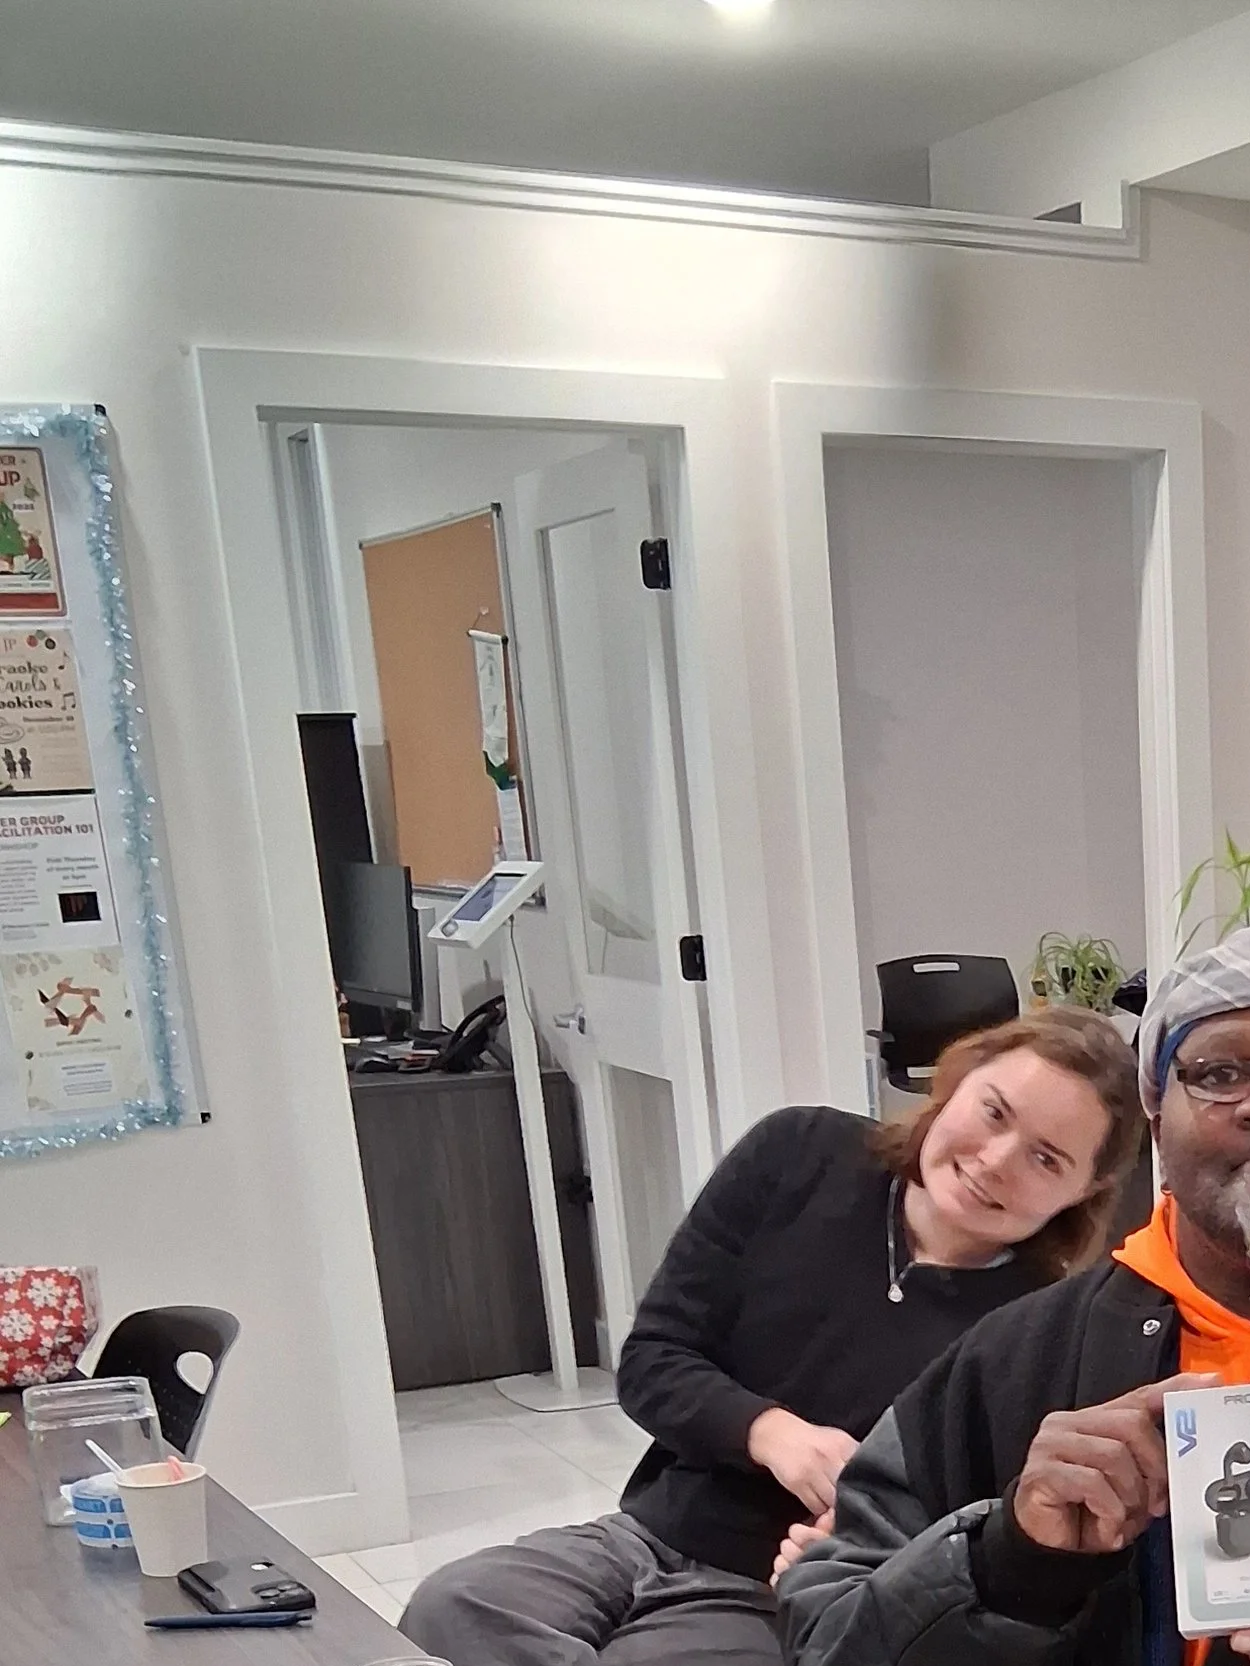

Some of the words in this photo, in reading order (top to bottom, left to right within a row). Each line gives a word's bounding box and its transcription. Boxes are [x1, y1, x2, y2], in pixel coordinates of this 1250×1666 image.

[20, 815, 65, 826] GROUP
[0, 825, 73, 838] CILITATION
[75, 824, 95, 834] 101
